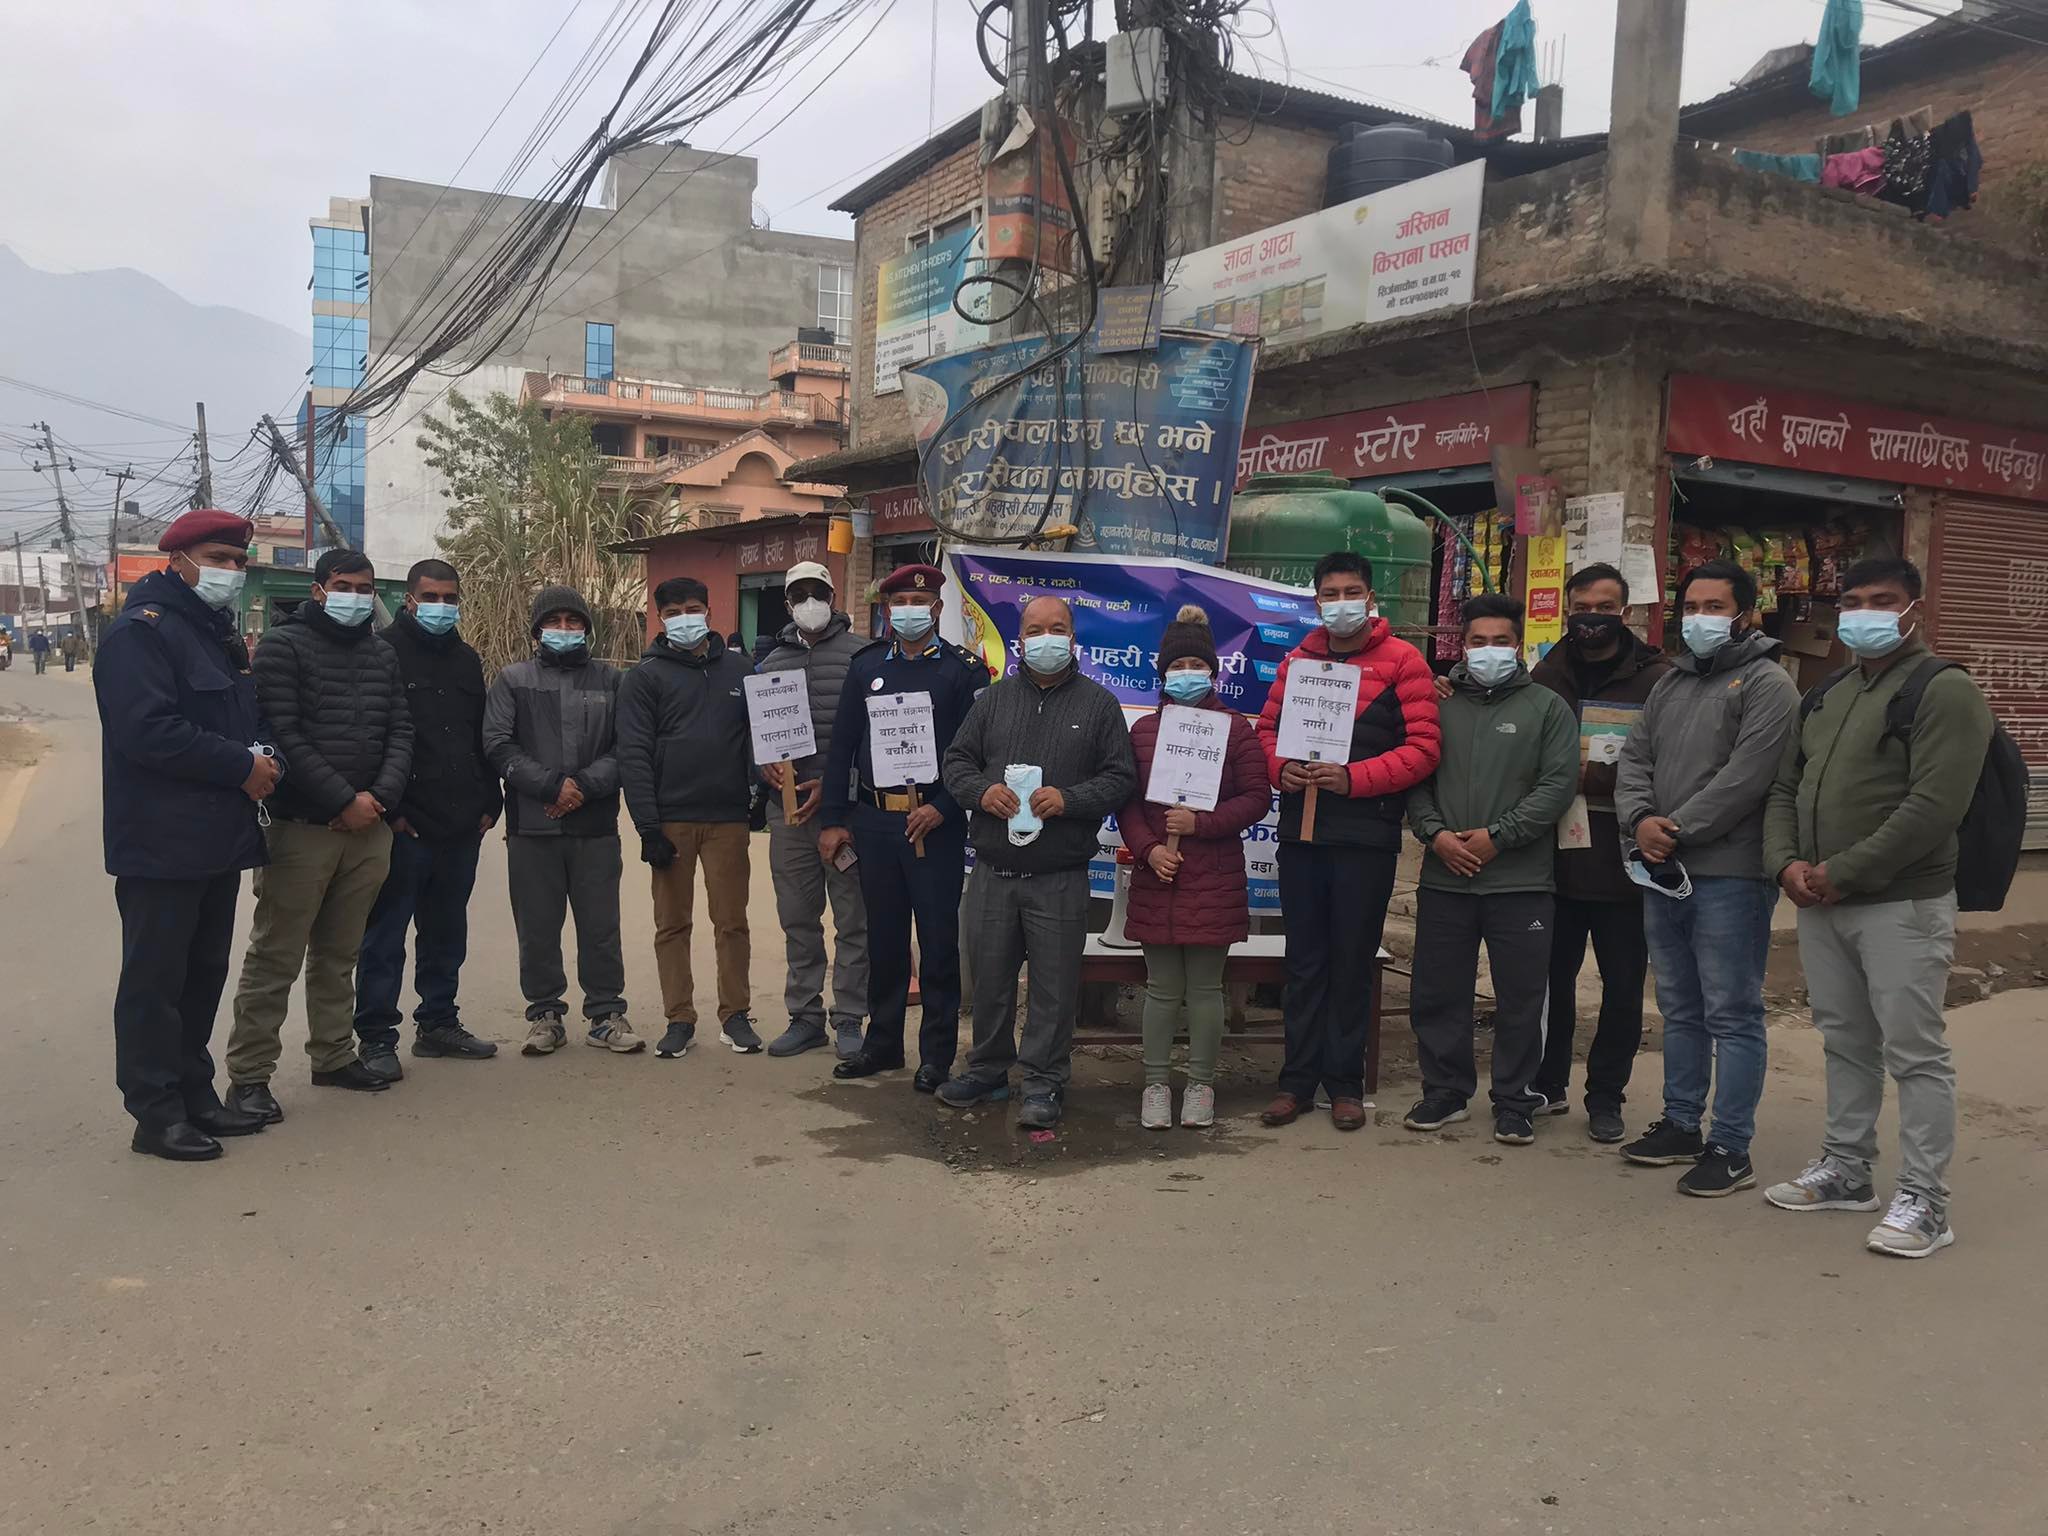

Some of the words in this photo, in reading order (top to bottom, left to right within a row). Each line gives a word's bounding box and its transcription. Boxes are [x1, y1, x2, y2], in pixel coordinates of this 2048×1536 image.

[1395, 208, 1451, 239] जस्मिन
[1259, 231, 1295, 261] आटा
[1372, 247, 1425, 275] किराना
[1429, 233, 1471, 260] पसल
[1729, 397, 1768, 443] यहाँ
[1781, 413, 1851, 457] पूजाको
[1157, 421, 1216, 453] भने
[1353, 416, 1426, 467] स्टोर
[884, 501, 901, 519] U.S.
[1039, 578, 1046, 587] र
[1270, 567, 1314, 582] PLUS
[1075, 595, 1101, 609] नेपाल
[1106, 599, 1131, 612] प्रहरी
[1299, 675, 1352, 690] अनावश्यक
[870, 707, 898, 719] कोरोना
[761, 729, 790, 743] पालना
[921, 724, 927, 734] र
[1166, 743, 1194, 758] मास्क
[1197, 745, 1221, 764] खोई
[1184, 771, 1192, 784] ?
[1250, 860, 1273, 873] वडा
